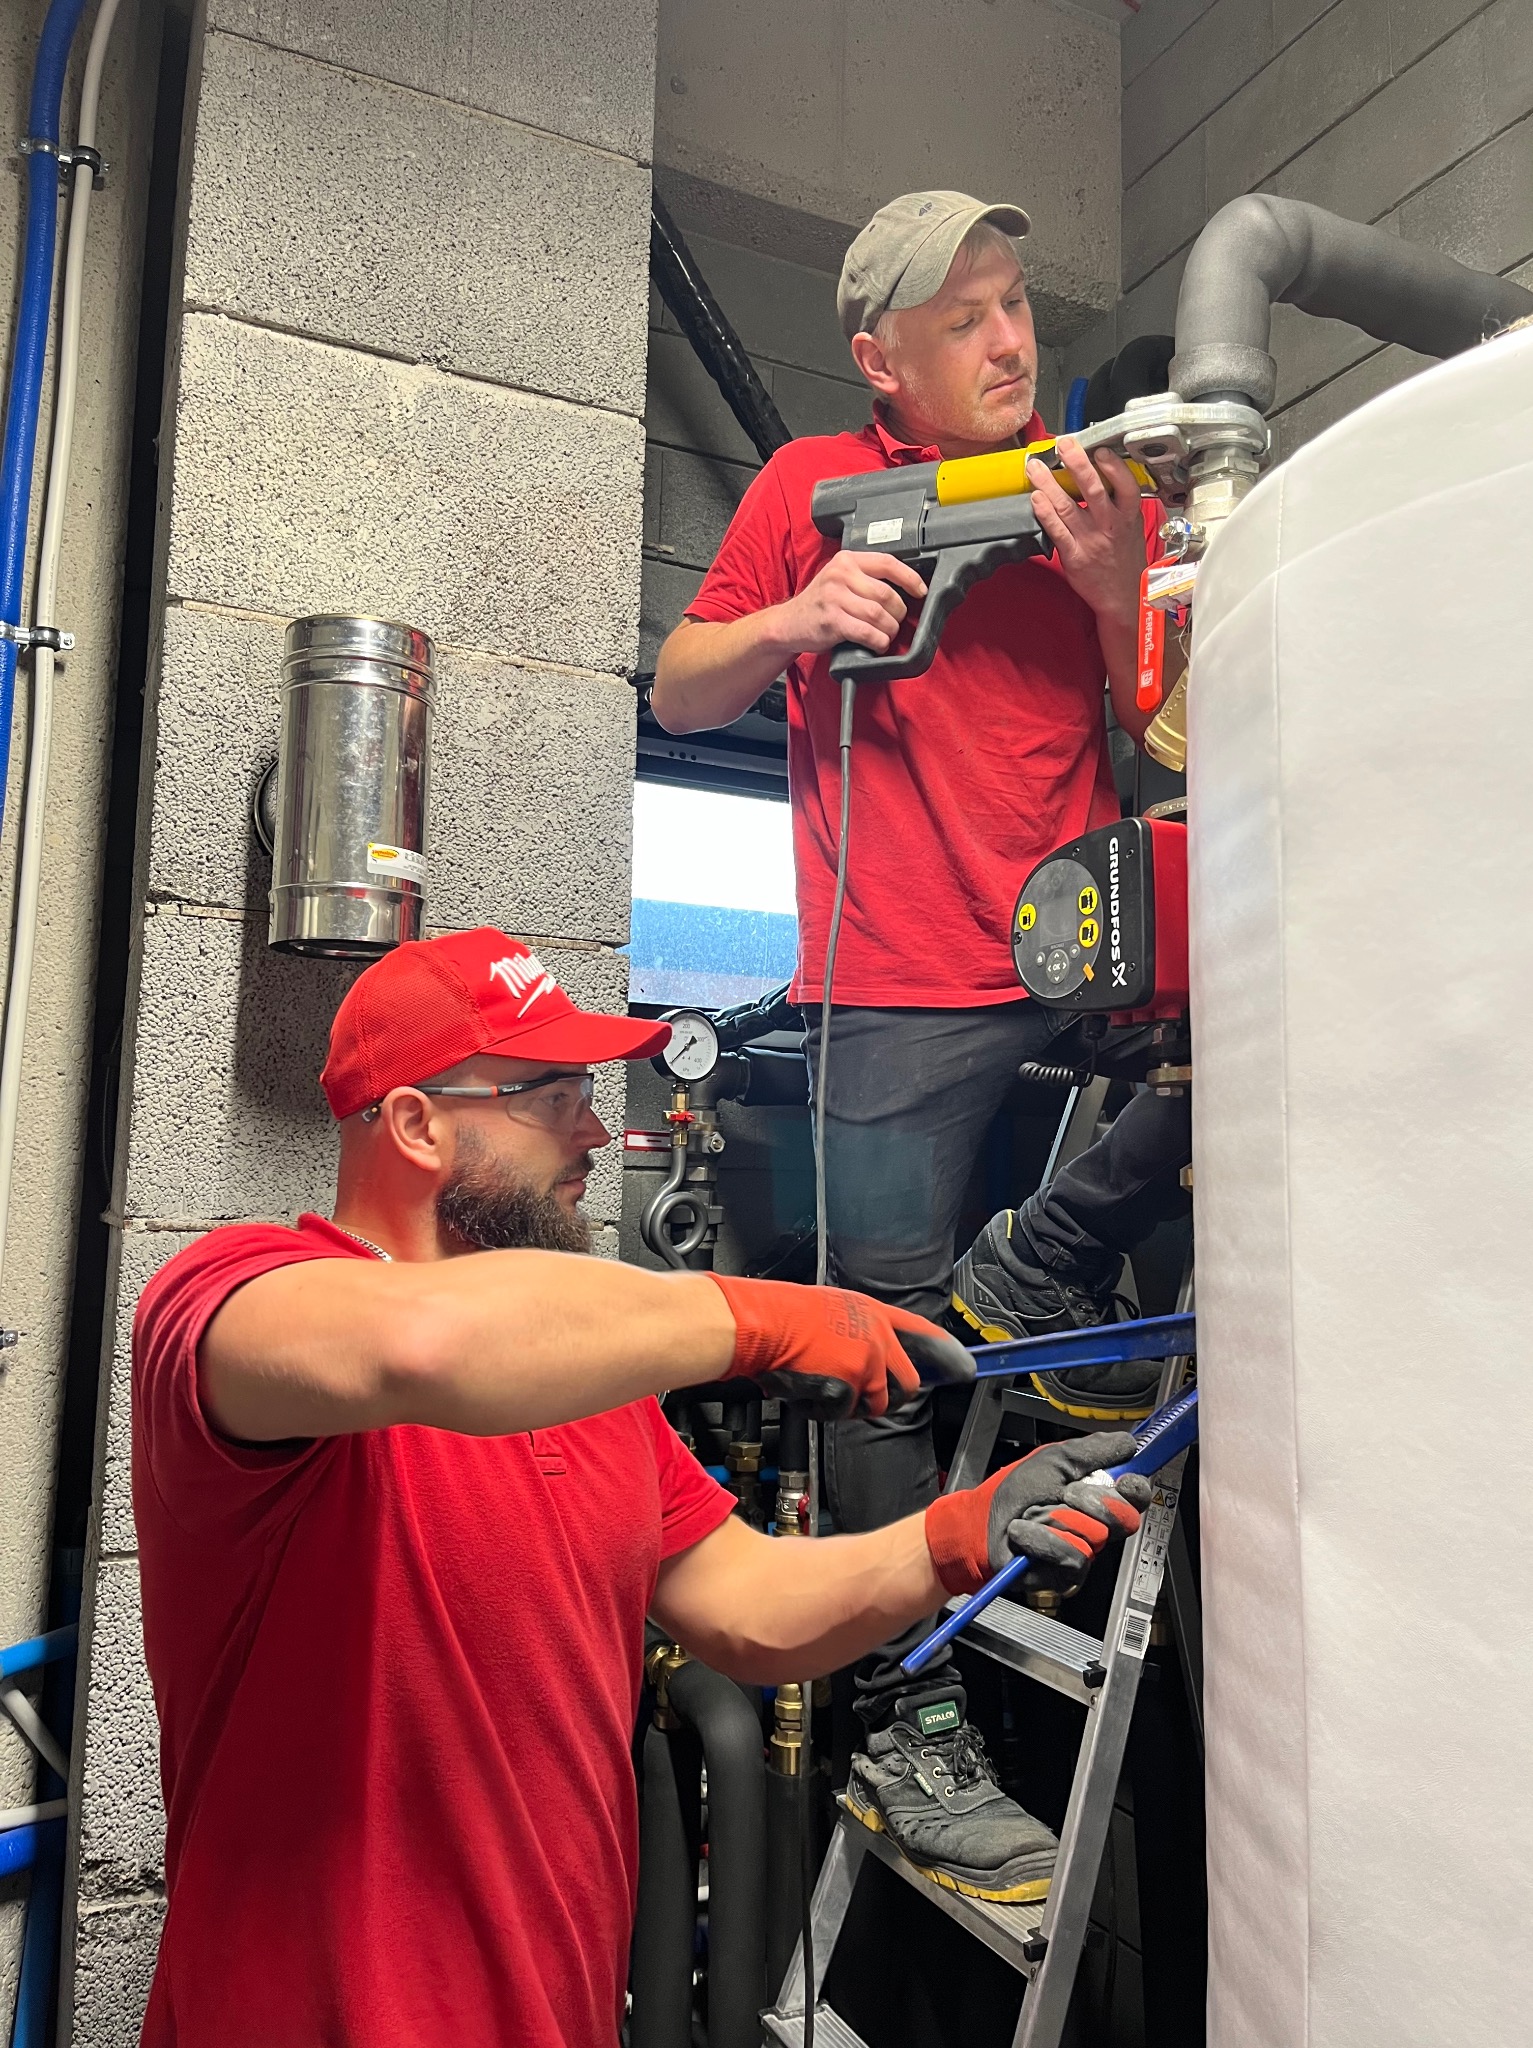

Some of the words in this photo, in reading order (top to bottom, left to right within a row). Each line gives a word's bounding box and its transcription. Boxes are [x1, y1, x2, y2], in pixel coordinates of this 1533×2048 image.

[1109, 837, 1121, 961] GRUNDFOS
[1052, 963, 1061, 971] OK
[925, 1710, 955, 1724] STALCO
